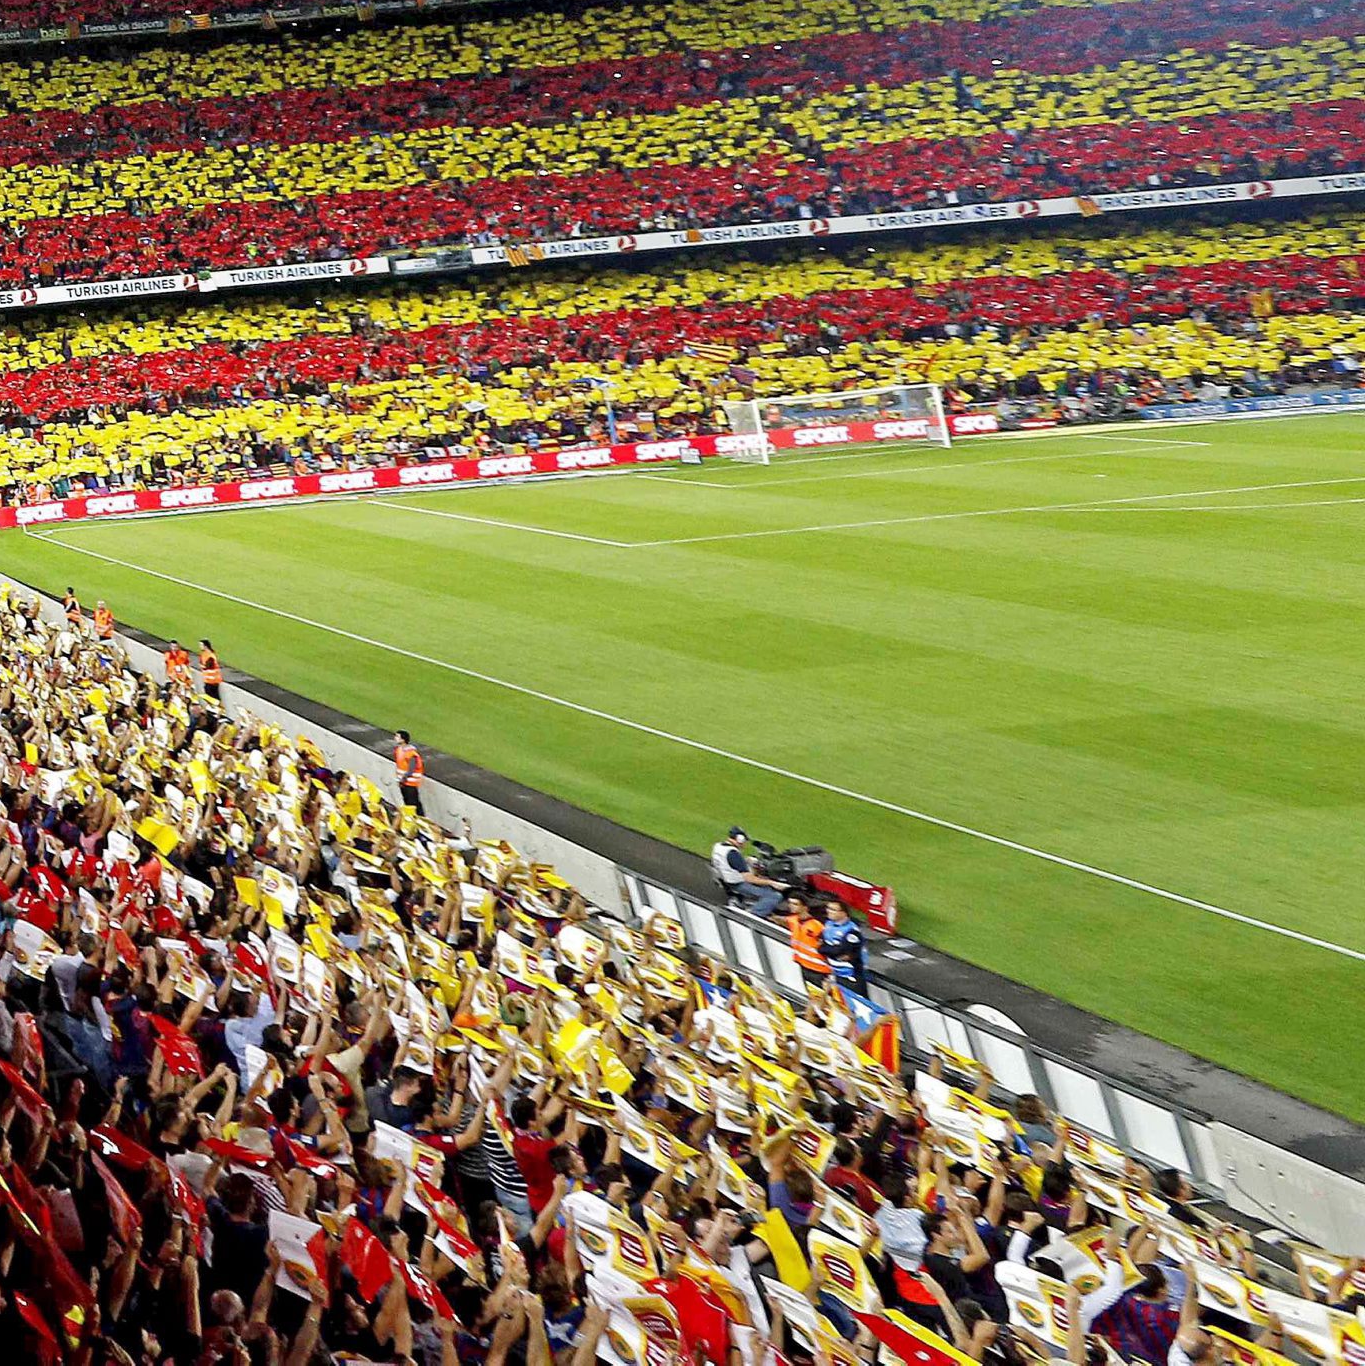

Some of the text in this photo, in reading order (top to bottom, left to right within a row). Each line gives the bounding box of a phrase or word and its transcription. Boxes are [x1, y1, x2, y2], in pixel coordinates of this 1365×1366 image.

[1159, 186, 1237, 204] AIRLINES
[866, 212, 934, 228] TURKISH
[670, 222, 801, 244] TUKISH AIRLINES
[549, 238, 610, 255] AIRLINES
[230, 263, 343, 283] TURKISH AIRLINES
[66, 277, 177, 298] TURKISH AIRLINES
